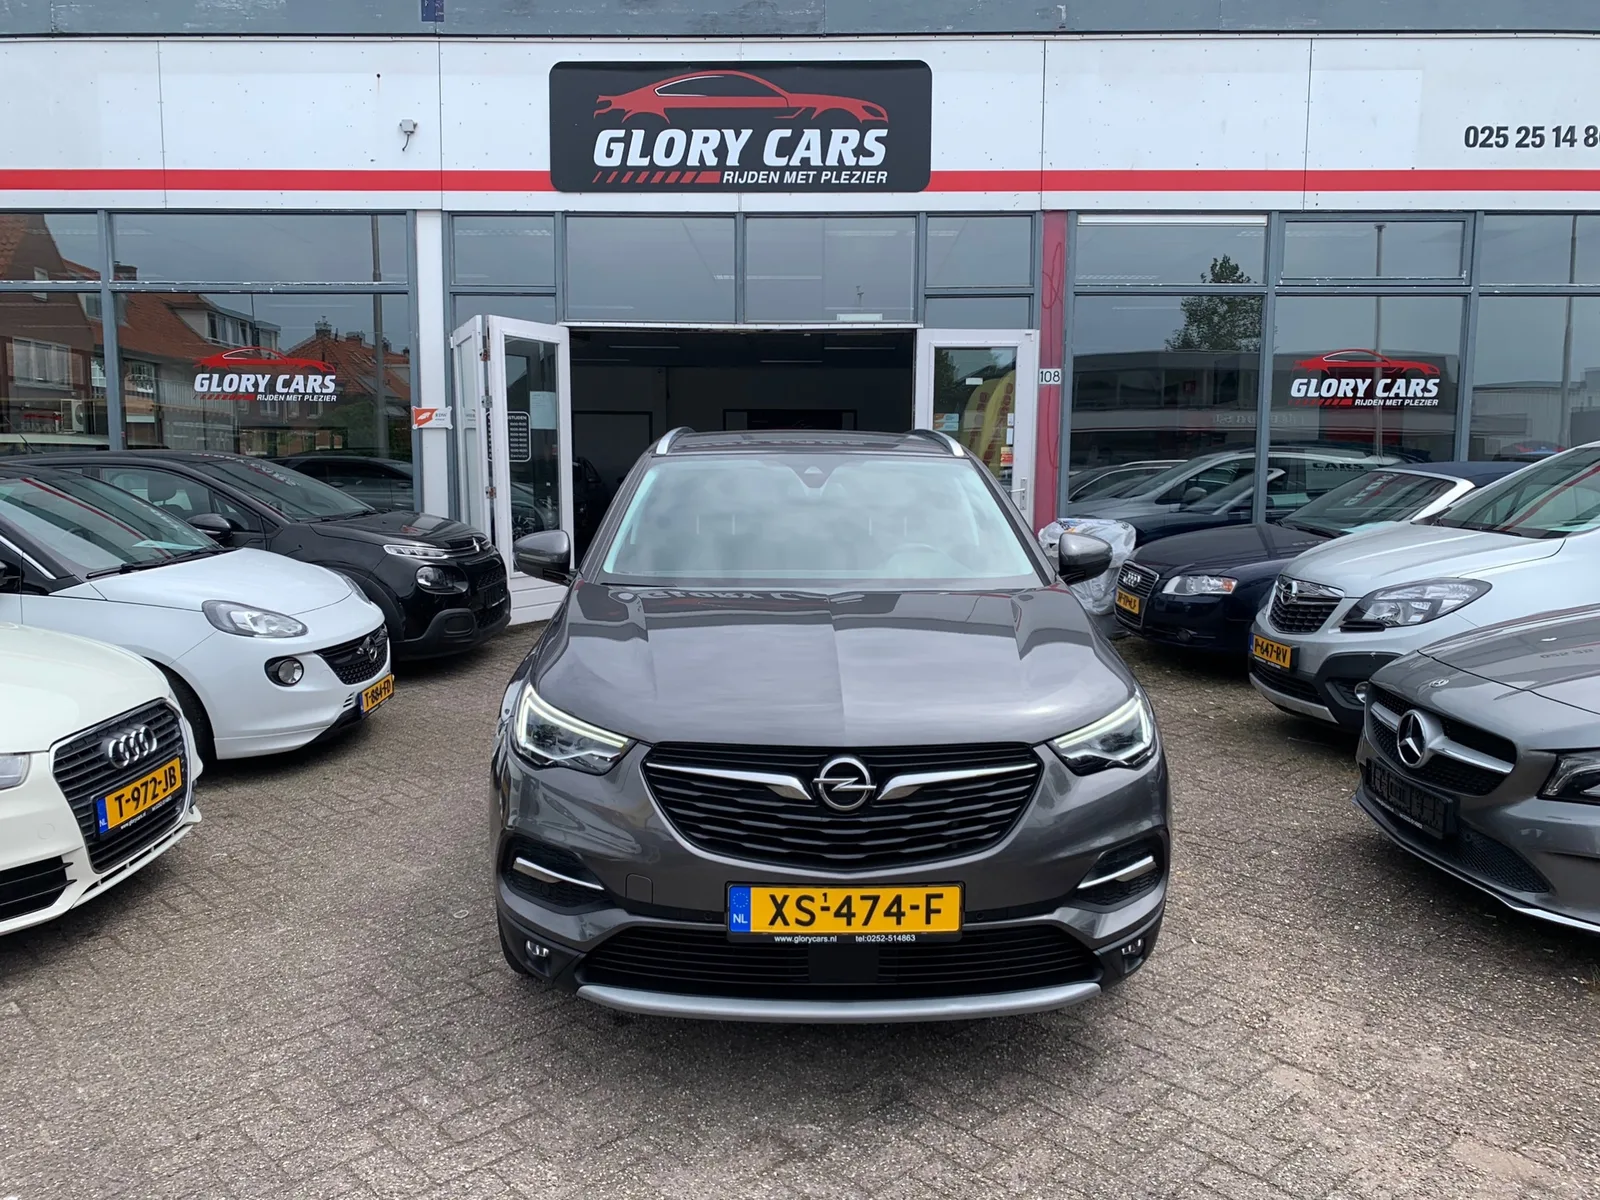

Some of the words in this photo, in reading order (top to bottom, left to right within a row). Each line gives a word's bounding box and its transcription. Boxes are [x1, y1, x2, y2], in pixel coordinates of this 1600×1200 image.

[1464, 125, 1509, 148] 025
[1515, 125, 1546, 148] 25
[1551, 125, 1578, 148] 14
[1583, 125, 1600, 148] 8
[593, 128, 753, 167] GLORY
[763, 128, 888, 167] CARS
[722, 171, 782, 184] RIJDEN
[783, 171, 819, 184] MET
[821, 171, 888, 184] PLEZIER
[1040, 370, 1061, 383] 108
[193, 373, 271, 393] GLORY
[275, 374, 336, 394] CARS
[1290, 378, 1372, 398] GLORY
[1375, 378, 1440, 398] CARS
[286, 394, 303, 402] MET
[304, 394, 337, 402] PLEZIER
[114, 765, 177, 819] T-972-JB
[99, 818, 108, 828] NL
[732, 913, 749, 925] NL
[774, 935, 838, 945] www.glorycars.nl
[855, 935, 916, 943] tel:0252-514863
